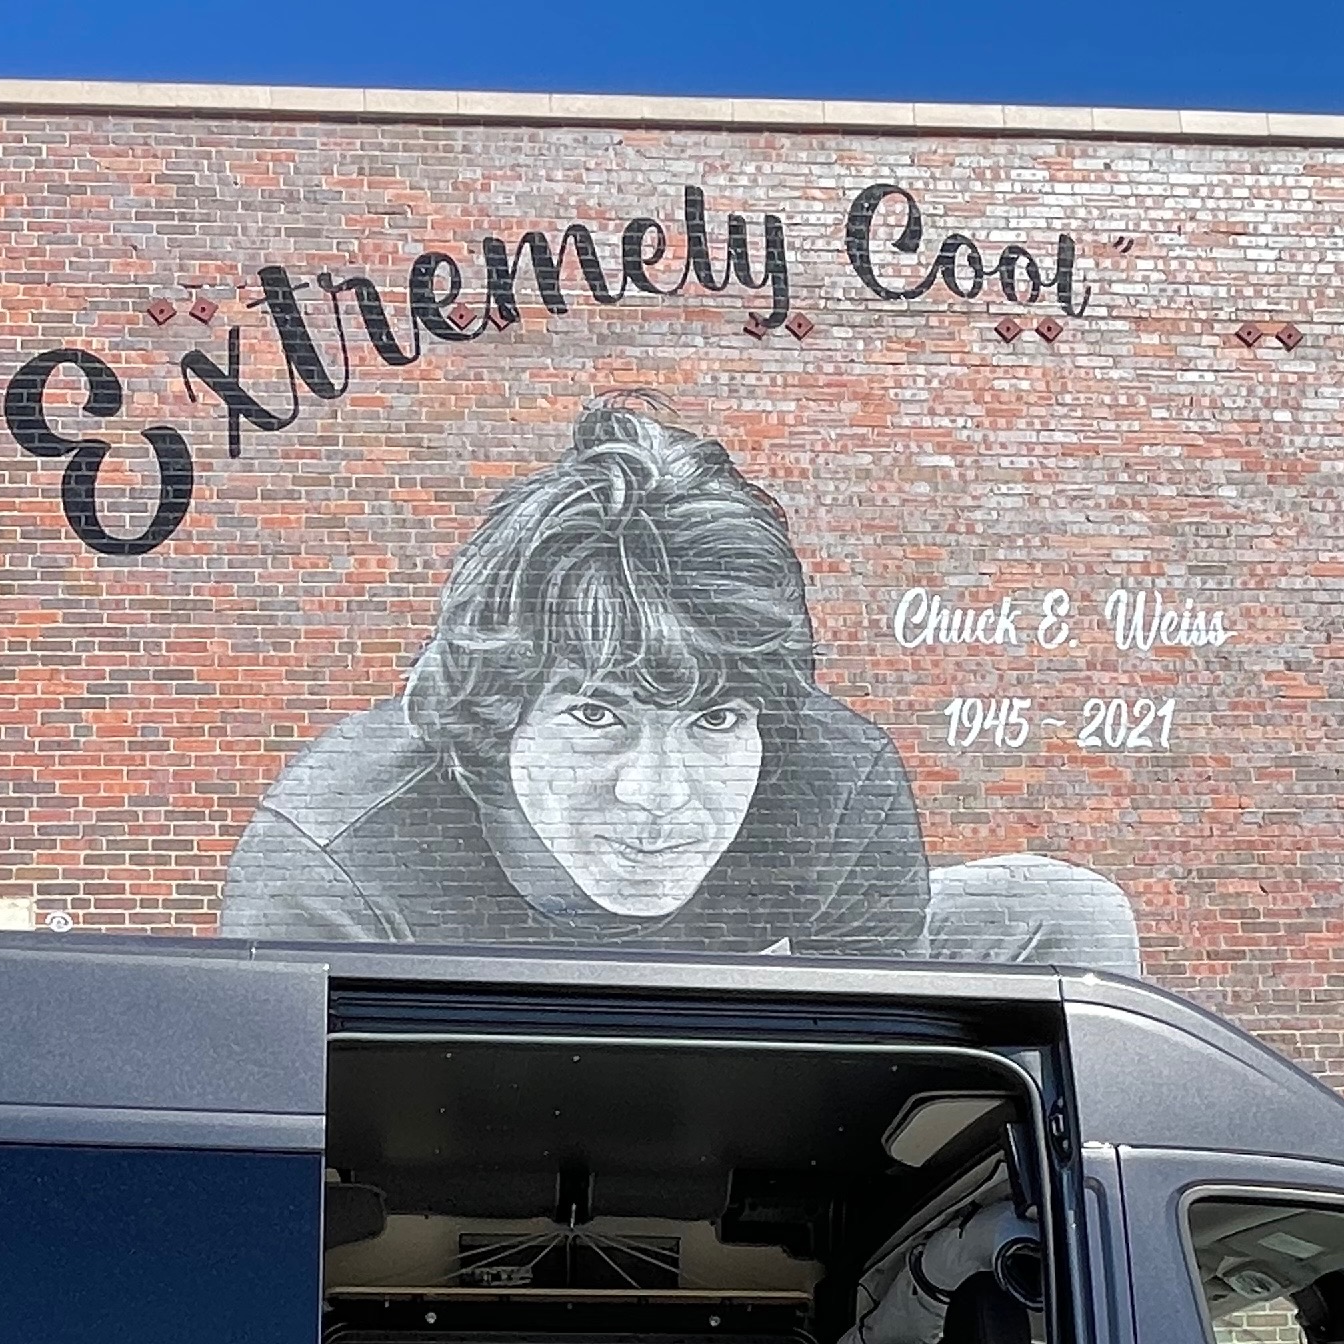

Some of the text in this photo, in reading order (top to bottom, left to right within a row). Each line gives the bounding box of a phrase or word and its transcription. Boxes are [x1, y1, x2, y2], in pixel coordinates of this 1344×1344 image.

[894, 587, 1239, 651] Chuck E. Weiss
[944, 697, 1032, 749] 1945
[1076, 697, 1177, 749] 2021
